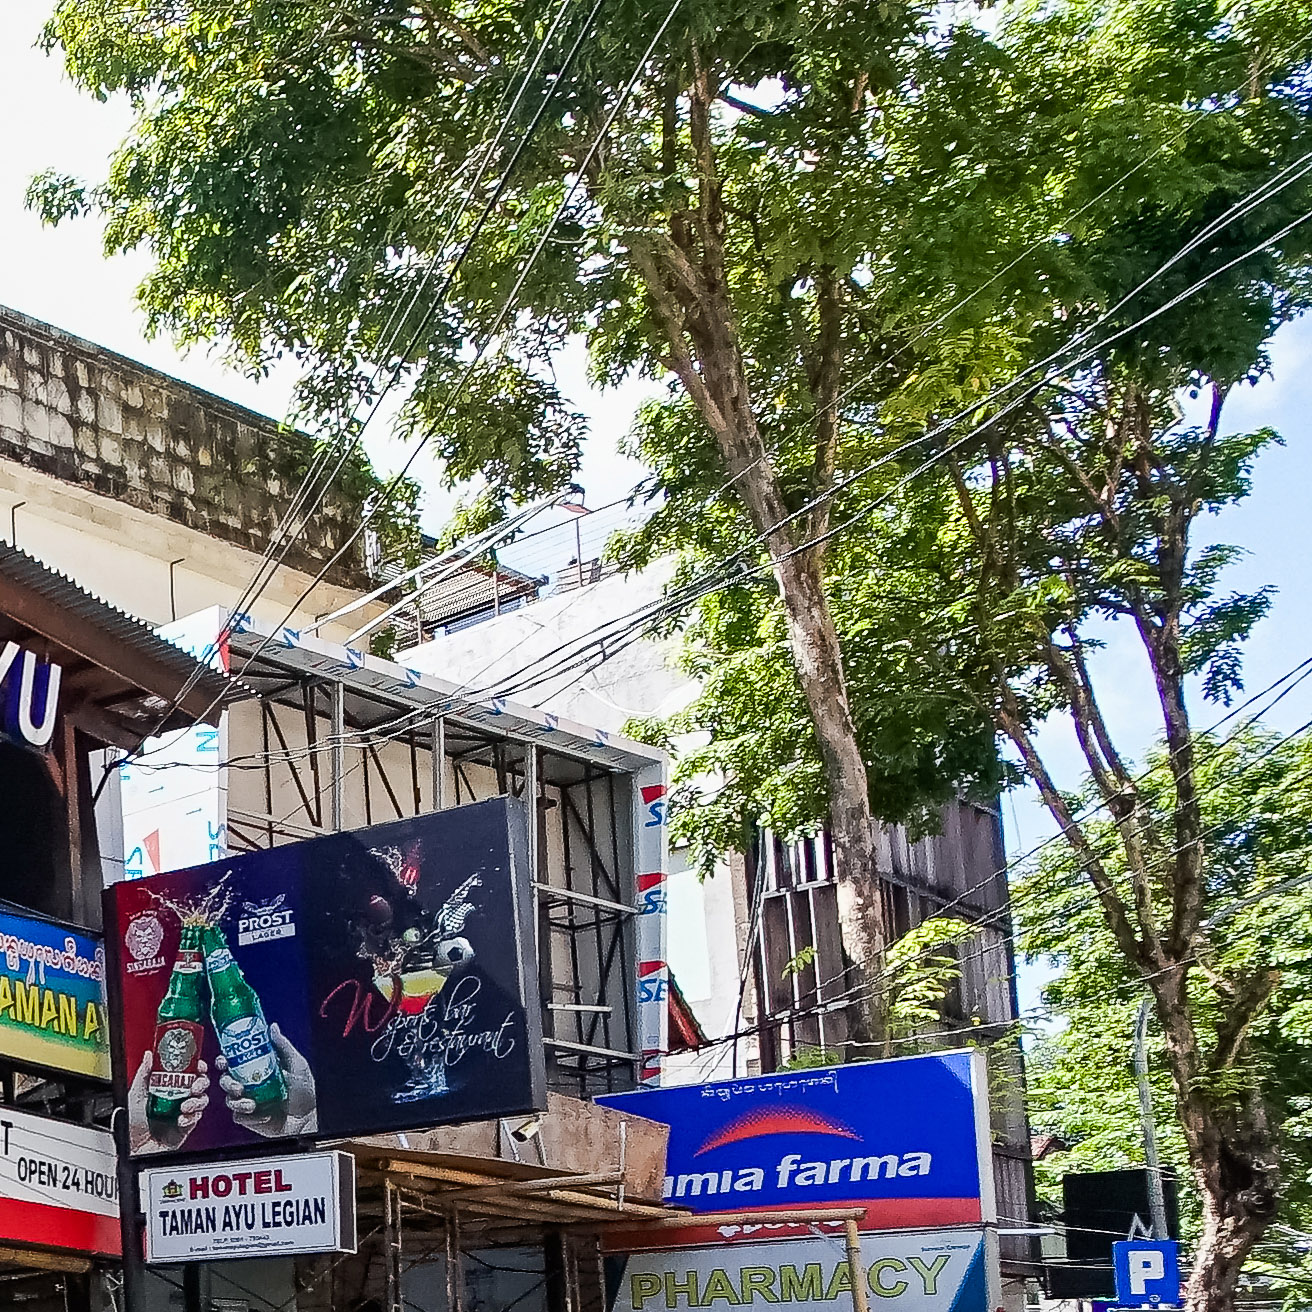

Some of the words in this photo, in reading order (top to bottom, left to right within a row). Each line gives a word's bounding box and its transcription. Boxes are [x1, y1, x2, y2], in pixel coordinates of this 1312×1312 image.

[238, 910, 294, 933] PROST
[444, 976, 481, 1025] bar
[225, 1030, 267, 1057] PROST
[17, 1157, 59, 1187] OPEN
[62, 1169, 80, 1190] 24
[188, 1169, 292, 1199] HOTEL
[776, 1151, 932, 1188] farma
[159, 1205, 216, 1237] TAMAN
[222, 1202, 256, 1231] AYU
[261, 1197, 326, 1228] LEGIAN
[630, 1254, 951, 1310] PHARMACY
[1128, 1251, 1164, 1294] P
